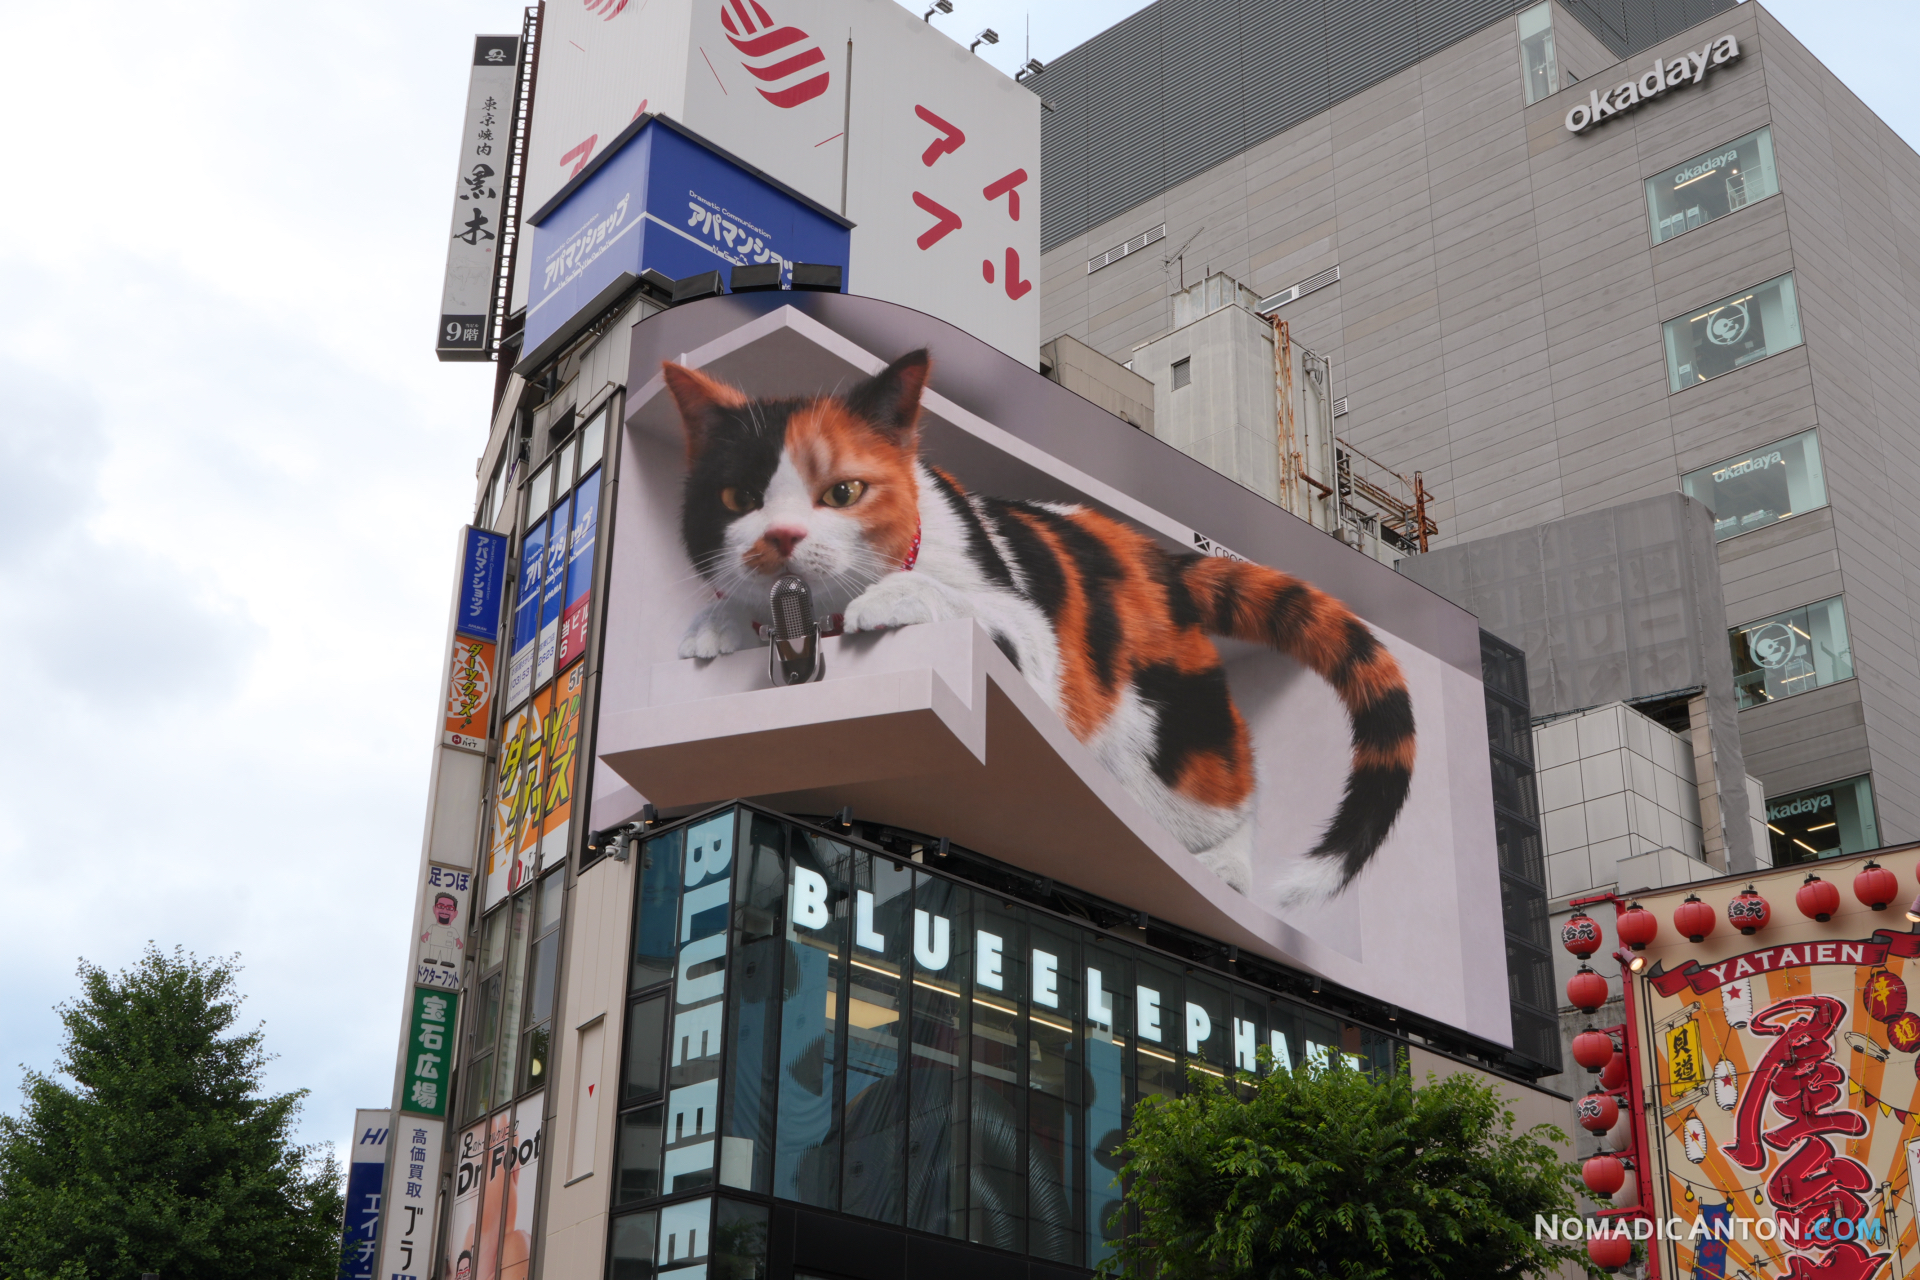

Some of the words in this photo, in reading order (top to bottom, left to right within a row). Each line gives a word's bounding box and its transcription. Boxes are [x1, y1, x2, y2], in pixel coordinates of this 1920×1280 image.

[1565, 34, 1741, 132] okadaya
[476, 96, 498, 156] 東京焼肉
[1674, 149, 1738, 184] okadaya
[452, 163, 497, 246] 黒木
[689, 189, 721, 212] Dramatic
[721, 207, 772, 240] Communication
[543, 192, 630, 291] アパマンショップ
[687, 201, 804, 280] アパマンショッ
[446, 321, 479, 342] 9階
[1714, 451, 1782, 483] okadaya
[469, 535, 490, 617] アパマンショップ
[561, 604, 589, 640] 当ビル
[459, 643, 484, 717] ダーツグッズ
[568, 662, 584, 692] 5F
[428, 866, 471, 892] 足つぼ
[671, 812, 735, 1069] BLUE
[1708, 943, 1865, 984] YATAIEN
[416, 964, 459, 989] ドクターフット
[411, 995, 448, 1109] 宝石広場
[405, 1128, 428, 1199] 高価買取
[457, 1161, 483, 1198] Dr
[489, 1128, 541, 1182] Foot
[657, 1077, 720, 1280] ELE
